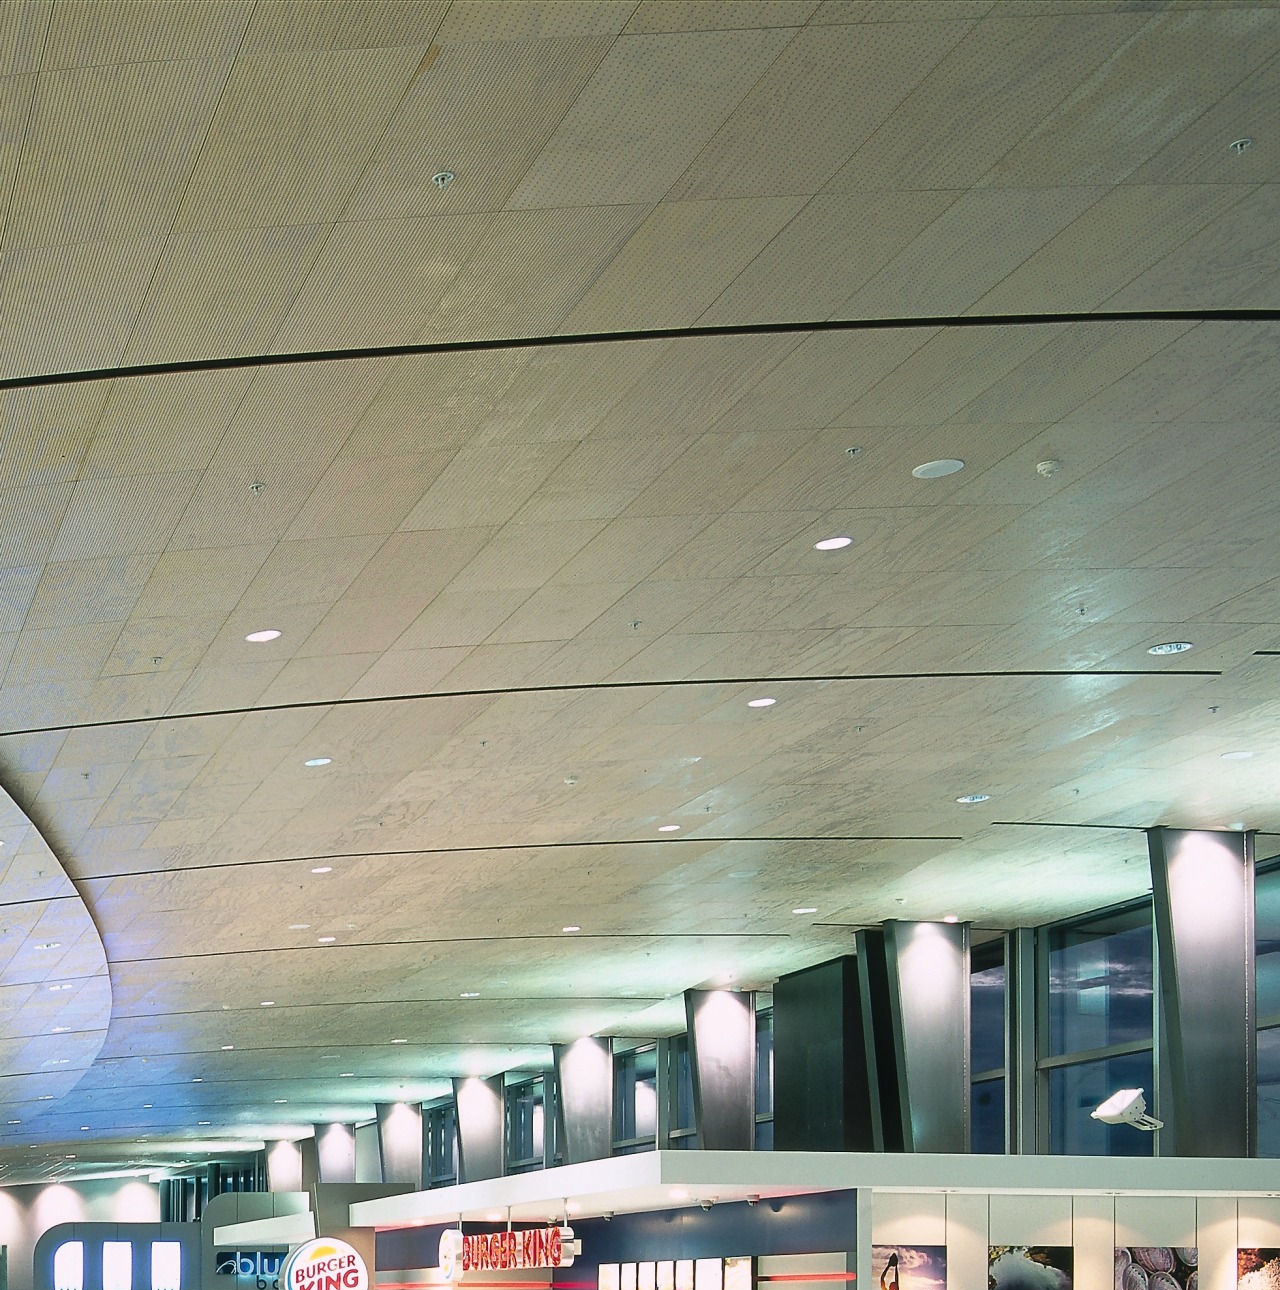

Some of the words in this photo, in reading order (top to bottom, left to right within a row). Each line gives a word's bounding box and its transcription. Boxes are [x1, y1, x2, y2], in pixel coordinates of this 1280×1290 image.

[236, 1251, 281, 1276] blu
[462, 1231, 518, 1271] BURGER
[522, 1226, 562, 1267] KING
[295, 1254, 356, 1284] BURGER
